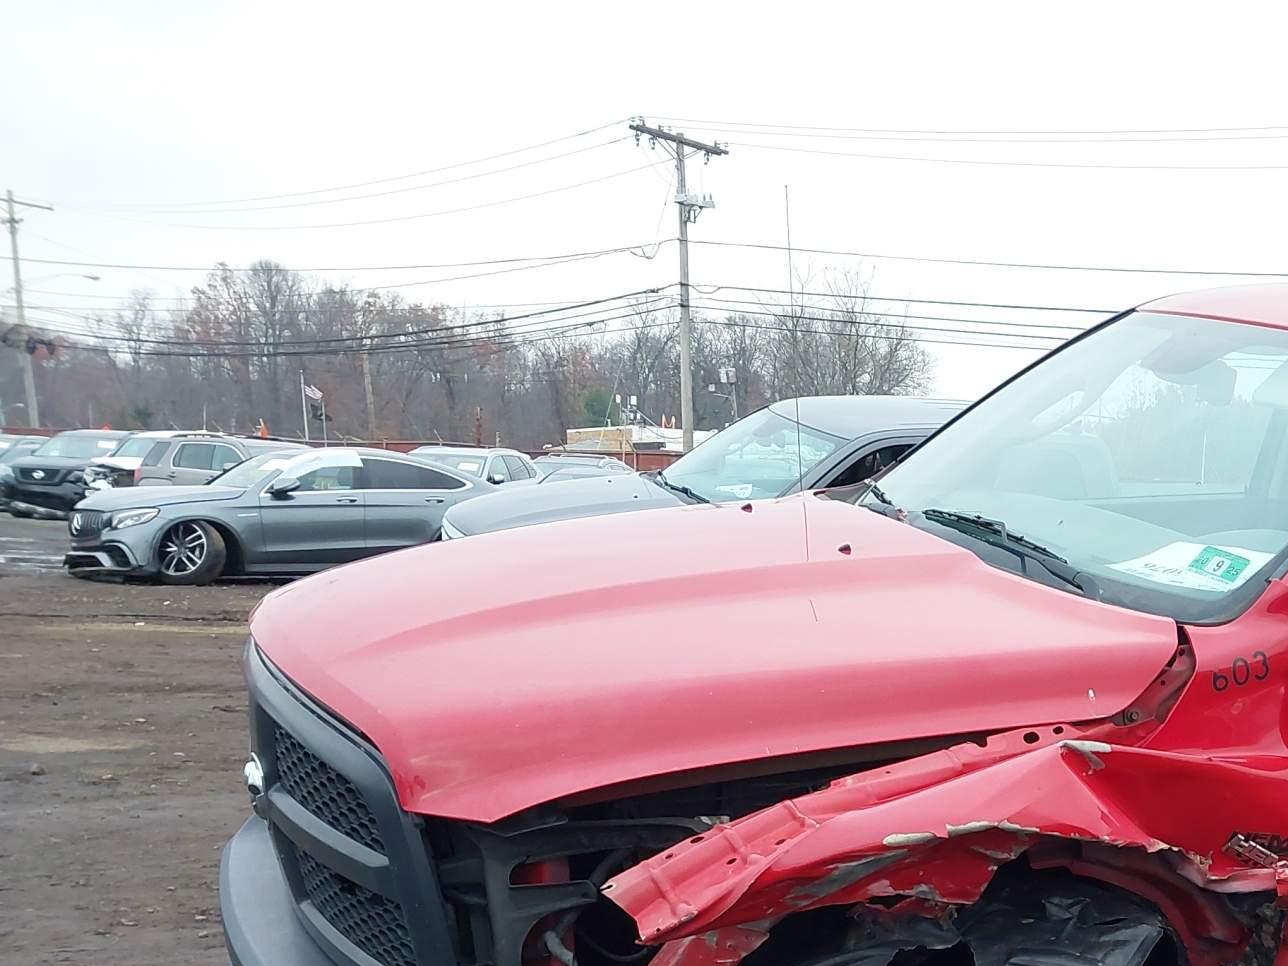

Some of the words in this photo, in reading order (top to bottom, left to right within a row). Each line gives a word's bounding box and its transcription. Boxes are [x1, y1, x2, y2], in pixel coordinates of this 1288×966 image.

[1213, 560, 1225, 572] 9
[1225, 566, 1241, 577] 25
[1212, 651, 1269, 692] 603
